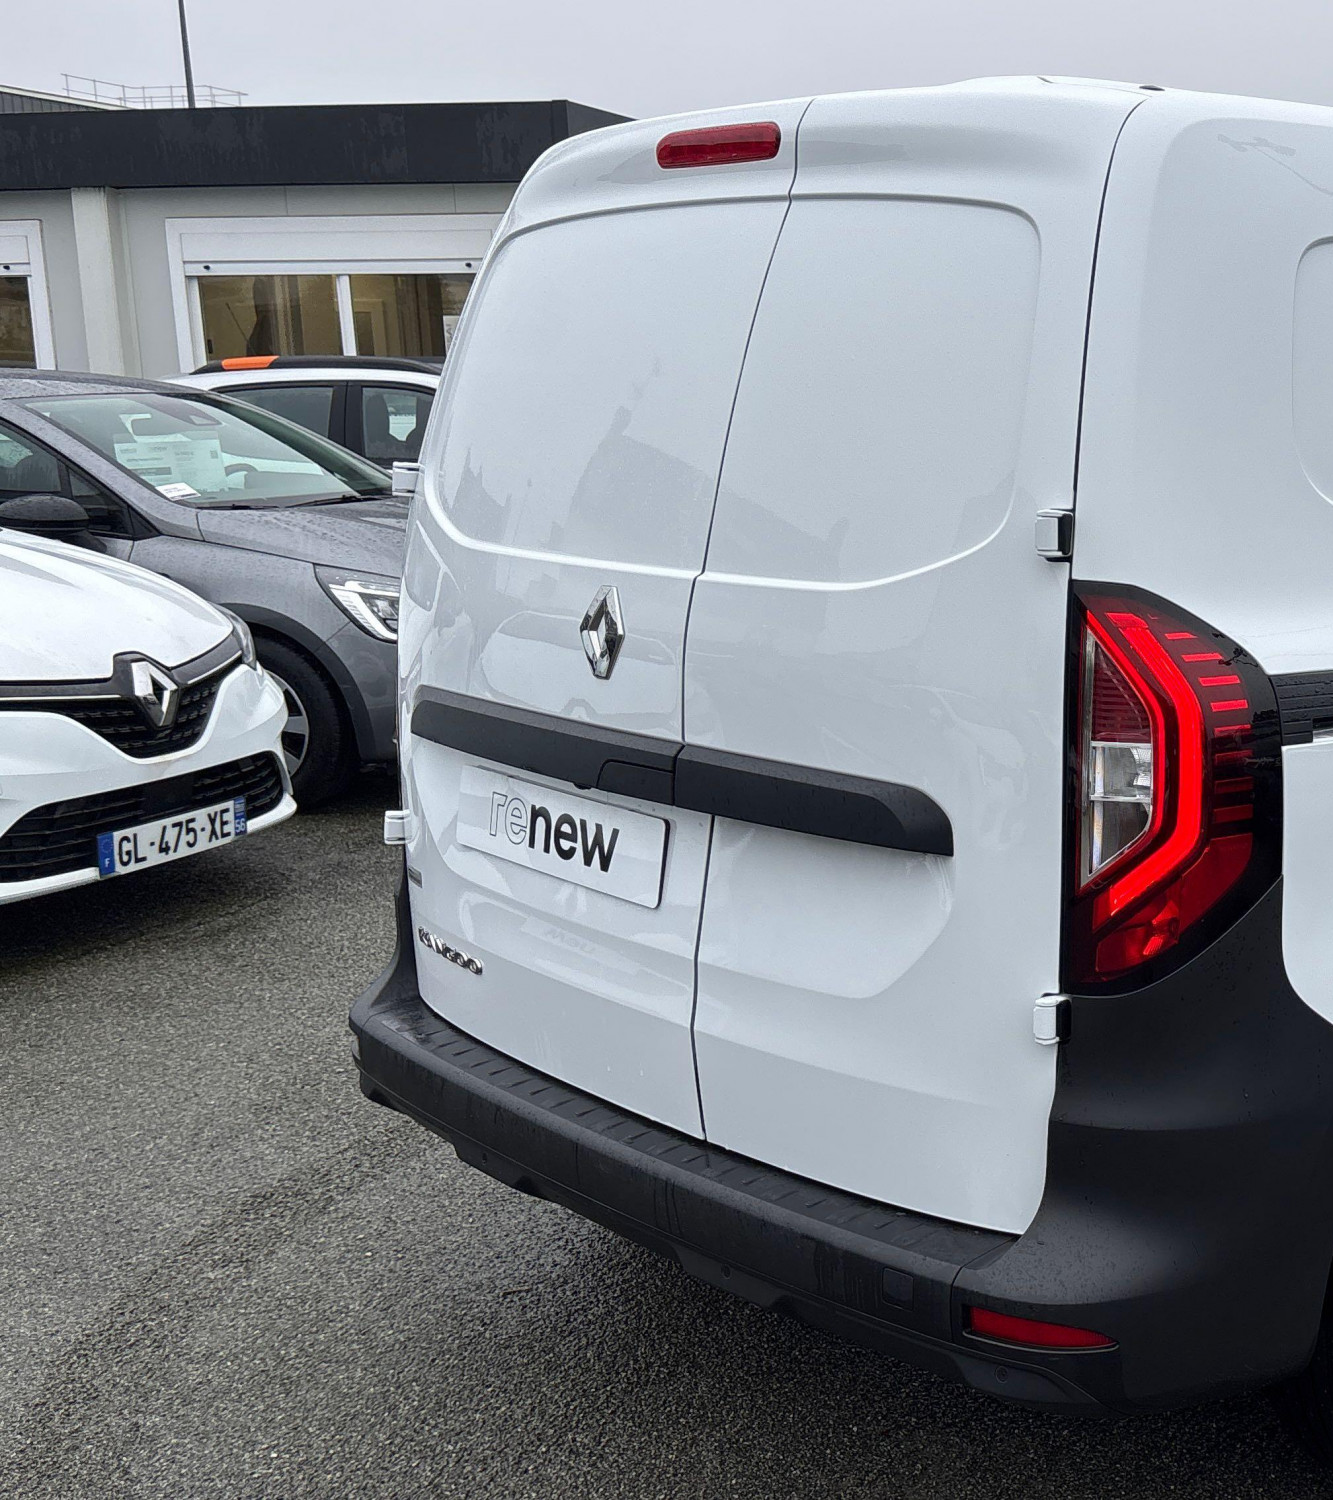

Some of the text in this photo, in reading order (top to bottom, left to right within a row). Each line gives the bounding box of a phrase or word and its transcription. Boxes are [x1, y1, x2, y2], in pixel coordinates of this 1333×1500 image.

[104, 807, 246, 868] F GL-475-XE 56
[489, 791, 620, 873] renew
